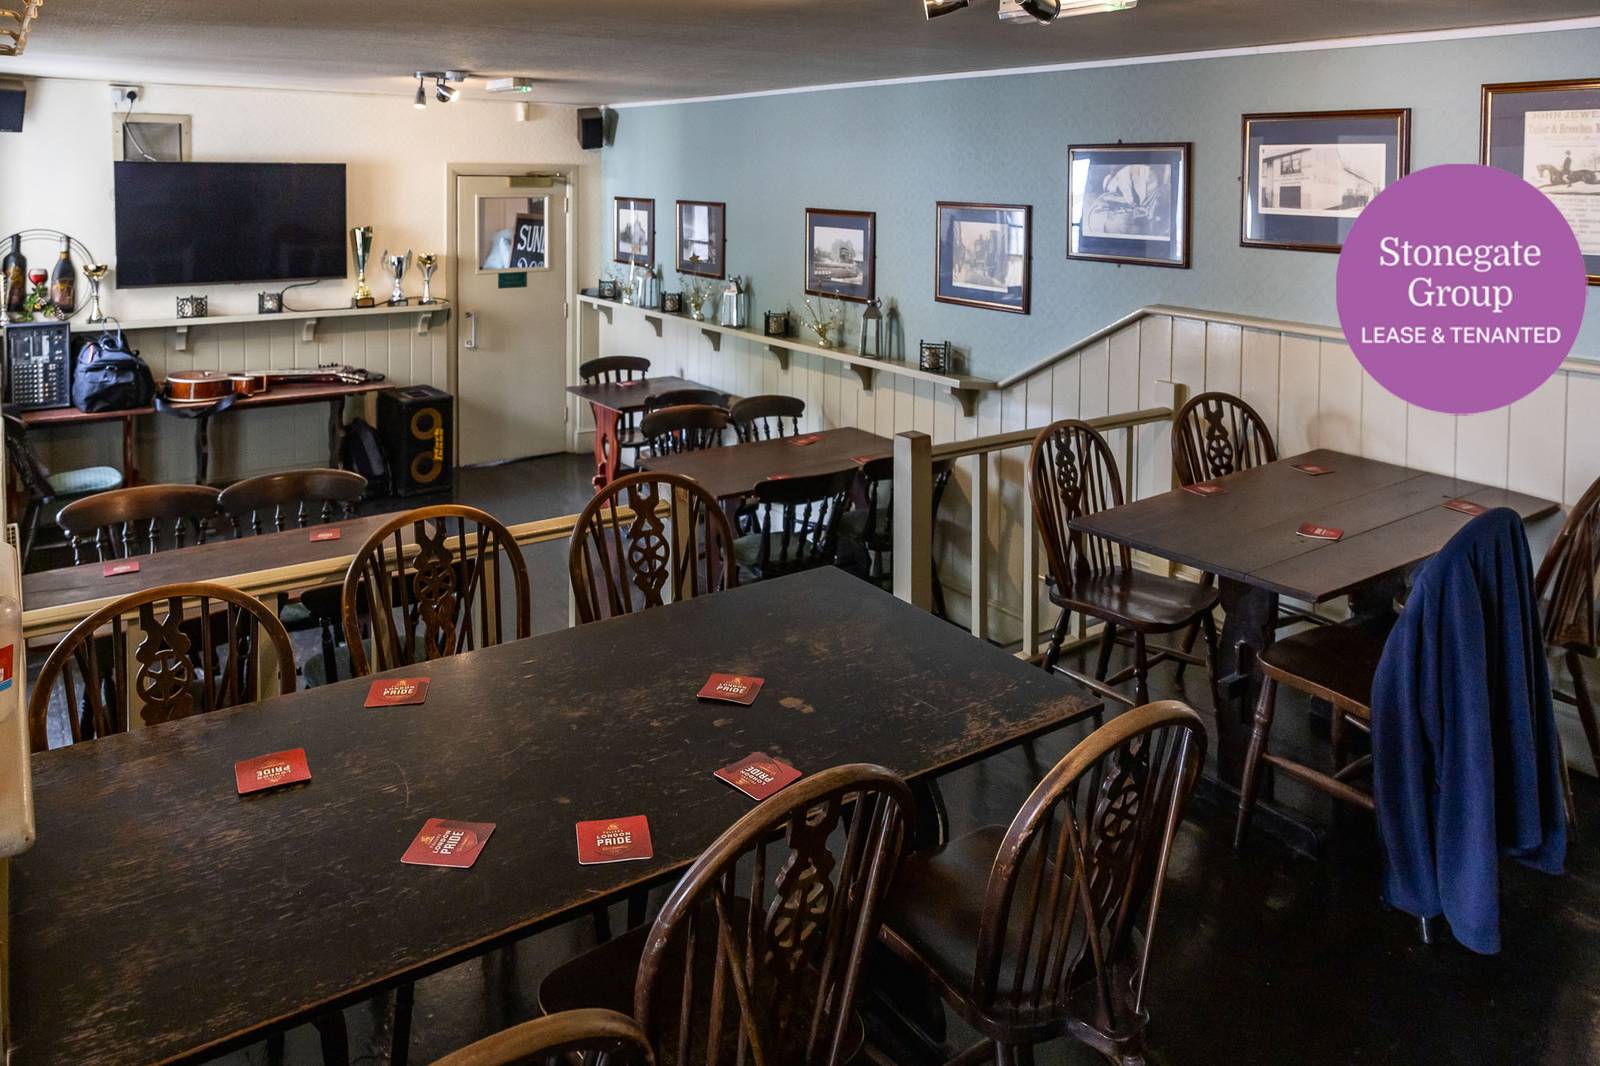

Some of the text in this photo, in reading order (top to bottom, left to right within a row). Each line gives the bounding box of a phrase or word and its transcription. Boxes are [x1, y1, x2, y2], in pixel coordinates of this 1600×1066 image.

[517, 224, 545, 253] SUN
[383, 687, 414, 696] PRIDE
[716, 685, 746, 694] PRIDE
[256, 764, 290, 777] PRIDE
[745, 765, 774, 783] PRIDE
[740, 770, 766, 786] LONDON
[432, 830, 452, 854] LONDON
[596, 831, 631, 839] LONDON
[596, 836, 632, 847] PRIDE
[440, 831, 464, 855] PRIDE
